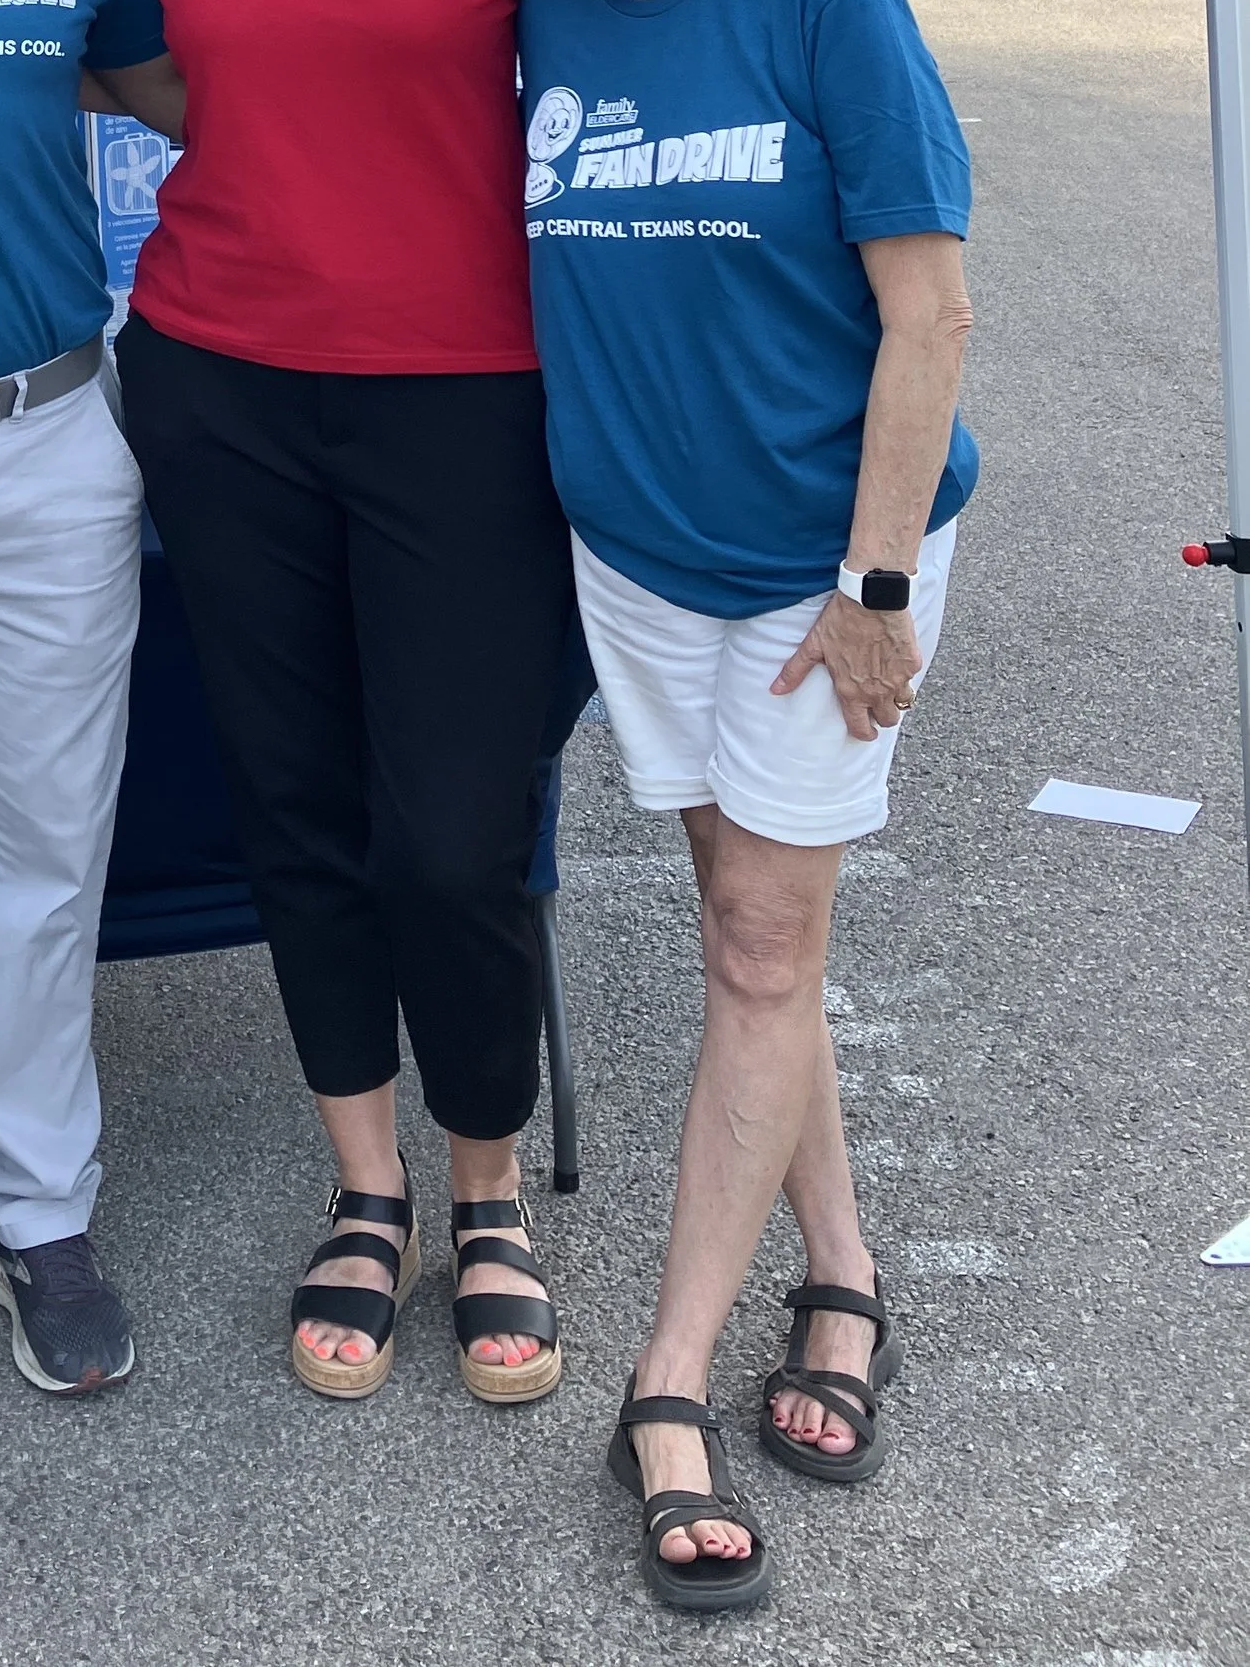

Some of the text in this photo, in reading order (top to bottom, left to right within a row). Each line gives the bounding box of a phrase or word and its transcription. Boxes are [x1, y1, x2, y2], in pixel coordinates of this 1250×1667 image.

[21, 39, 65, 57] COOL.
[596, 97, 635, 114] family
[579, 128, 644, 152] SUMMER
[570, 121, 786, 188] FAN DRIVE
[527, 219, 761, 239] EEP CENTRAL TEXANS COOL.
